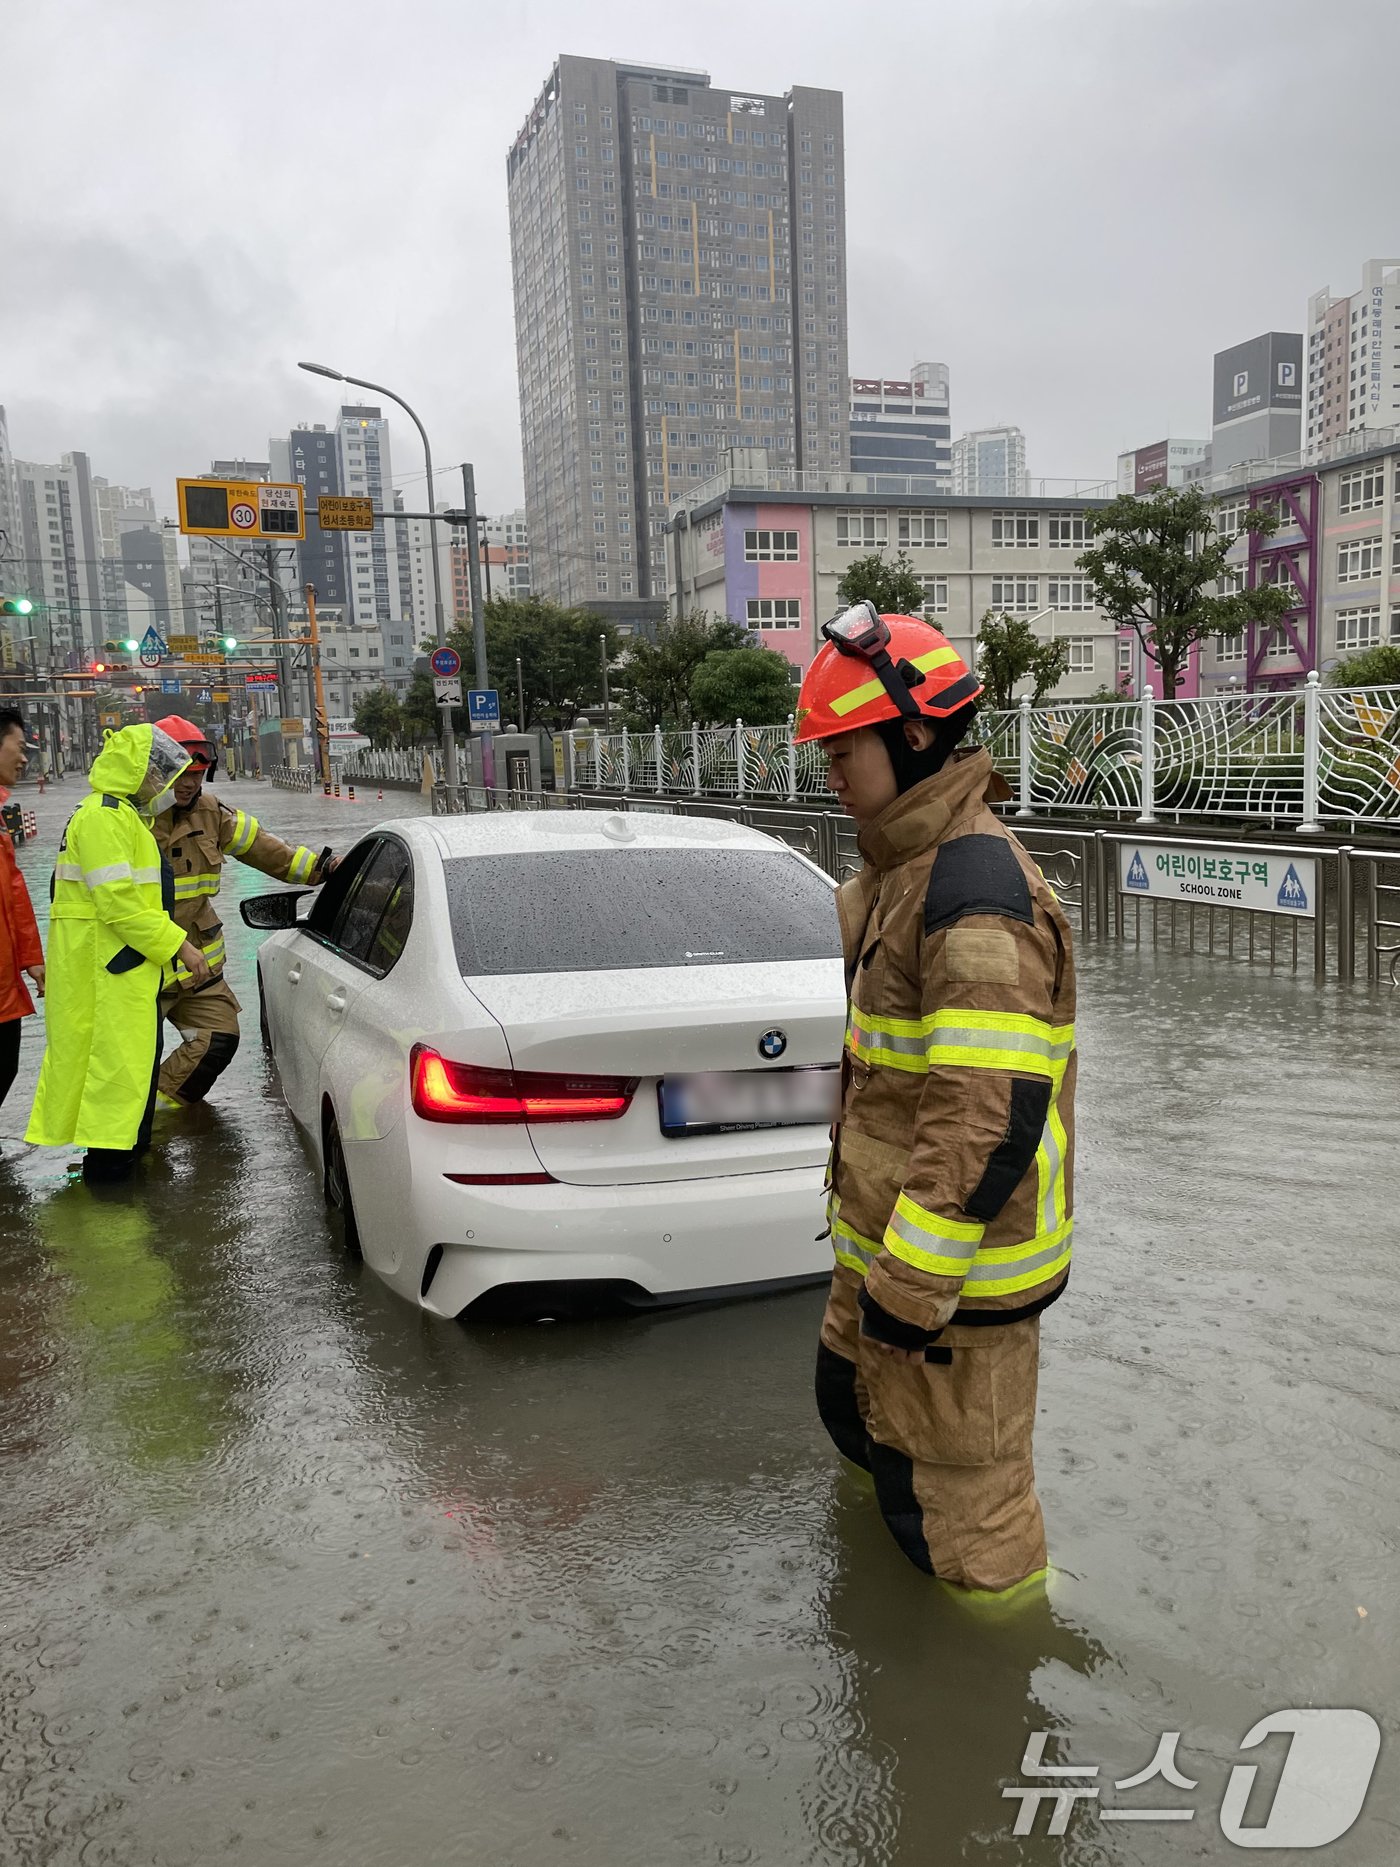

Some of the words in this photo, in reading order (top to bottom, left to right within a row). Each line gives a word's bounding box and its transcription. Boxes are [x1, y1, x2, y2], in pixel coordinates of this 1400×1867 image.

[1282, 364, 1292, 384] P
[1237, 374, 1246, 395] P
[265, 489, 292, 498] 당신의
[261, 499, 297, 509] 현재속도
[320, 500, 371, 512] 어린이보호구역
[235, 510, 252, 523] 30
[322, 514, 372, 526] 성서초등학교
[476, 695, 486, 709] P
[1156, 853, 1268, 887] 어린이보호구역
[1180, 882, 1216, 897] SCHOOL
[1217, 887, 1242, 900] ZONE
